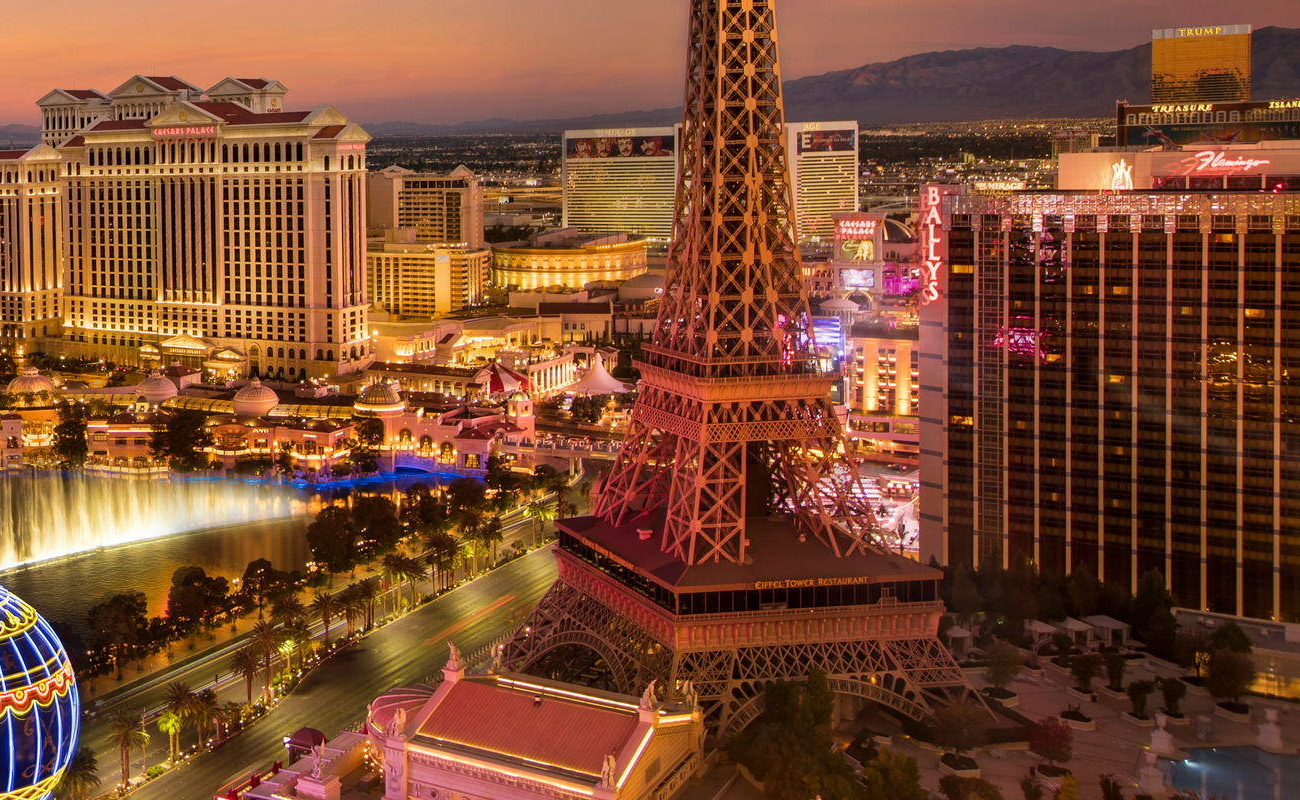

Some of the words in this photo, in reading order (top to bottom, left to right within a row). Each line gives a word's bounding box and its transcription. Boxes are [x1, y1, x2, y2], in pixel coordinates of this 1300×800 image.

[1178, 26, 1222, 37] TRUMP
[1151, 103, 1213, 113] TREASURE
[153, 127, 184, 136] CAESARS
[186, 126, 215, 135] PALACE
[604, 128, 637, 137] MIRAGE
[1194, 150, 1270, 171] Flamingo
[987, 182, 1024, 190] MIRAGE
[839, 220, 876, 228] CAESARS
[925, 186, 942, 301] BALLYS
[754, 580, 784, 590] EIFFEL
[784, 578, 815, 588] TOWER
[817, 576, 869, 586] RESTAURANT
